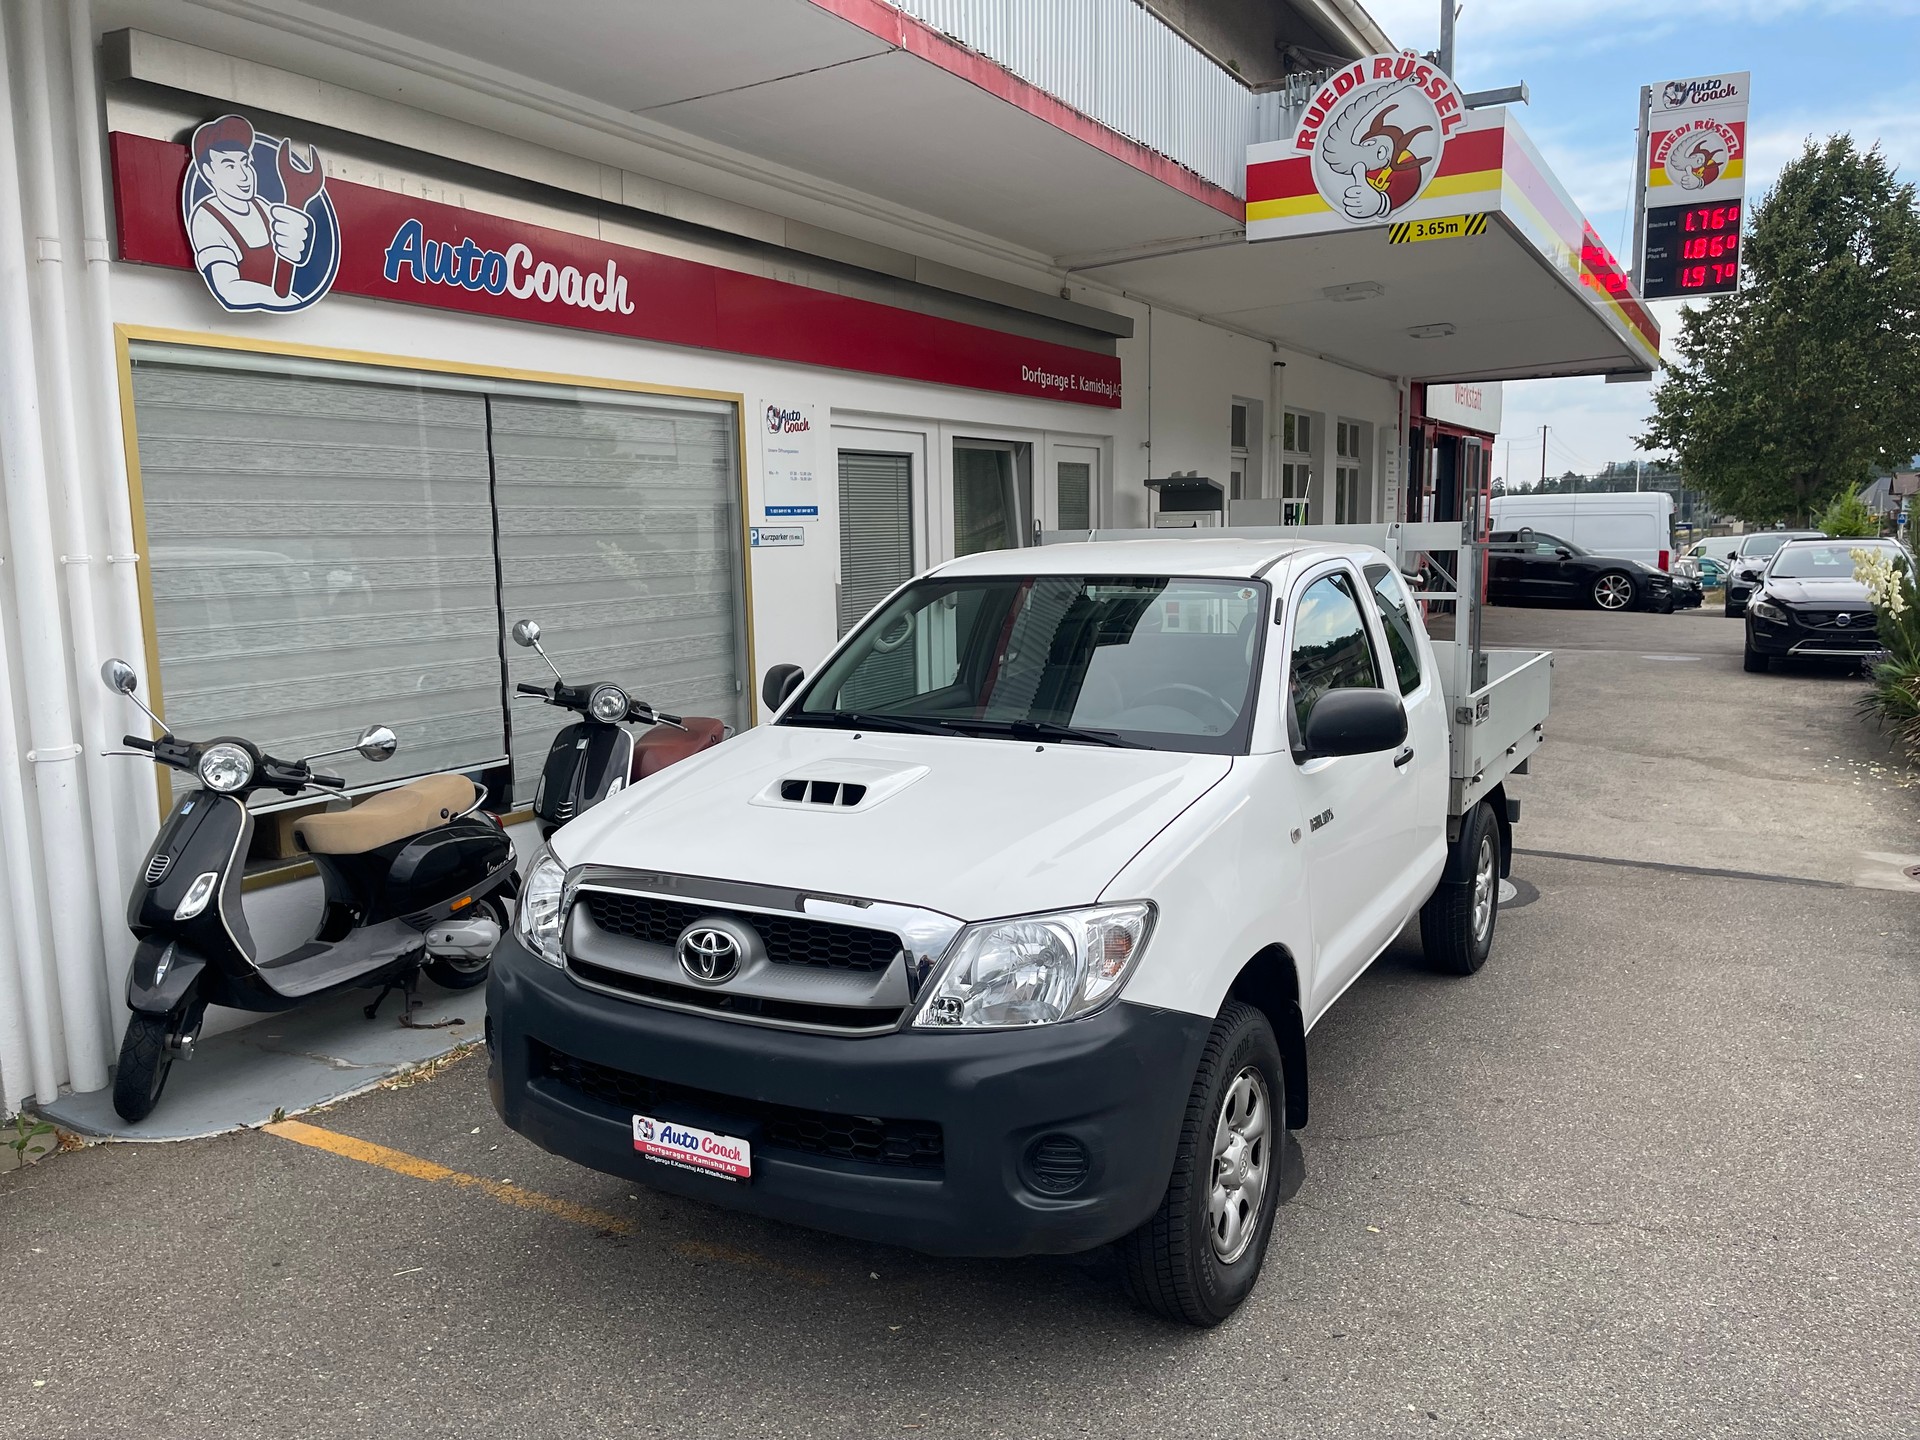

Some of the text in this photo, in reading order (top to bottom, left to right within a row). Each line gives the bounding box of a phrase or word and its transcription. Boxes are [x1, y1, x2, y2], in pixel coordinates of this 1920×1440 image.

[1687, 79, 1722, 97] Auto
[1691, 83, 1738, 104] Coach
[1296, 51, 1462, 150] RUEDI RÜSSEL
[1657, 117, 1737, 161] RUEDI RÜSSEL
[1416, 222, 1459, 237] 3.65m
[1022, 365, 1069, 391] Dorfgarage
[1070, 374, 1078, 390] E.
[1079, 375, 1112, 399] Kamishaj
[781, 409, 801, 424] Auto
[784, 417, 811, 434] Coach
[761, 533, 789, 542] Kurzparker
[660, 1125, 742, 1162] Auto Coach
[646, 1144, 737, 1172] Dorfgarage E.Kamishaj AG
